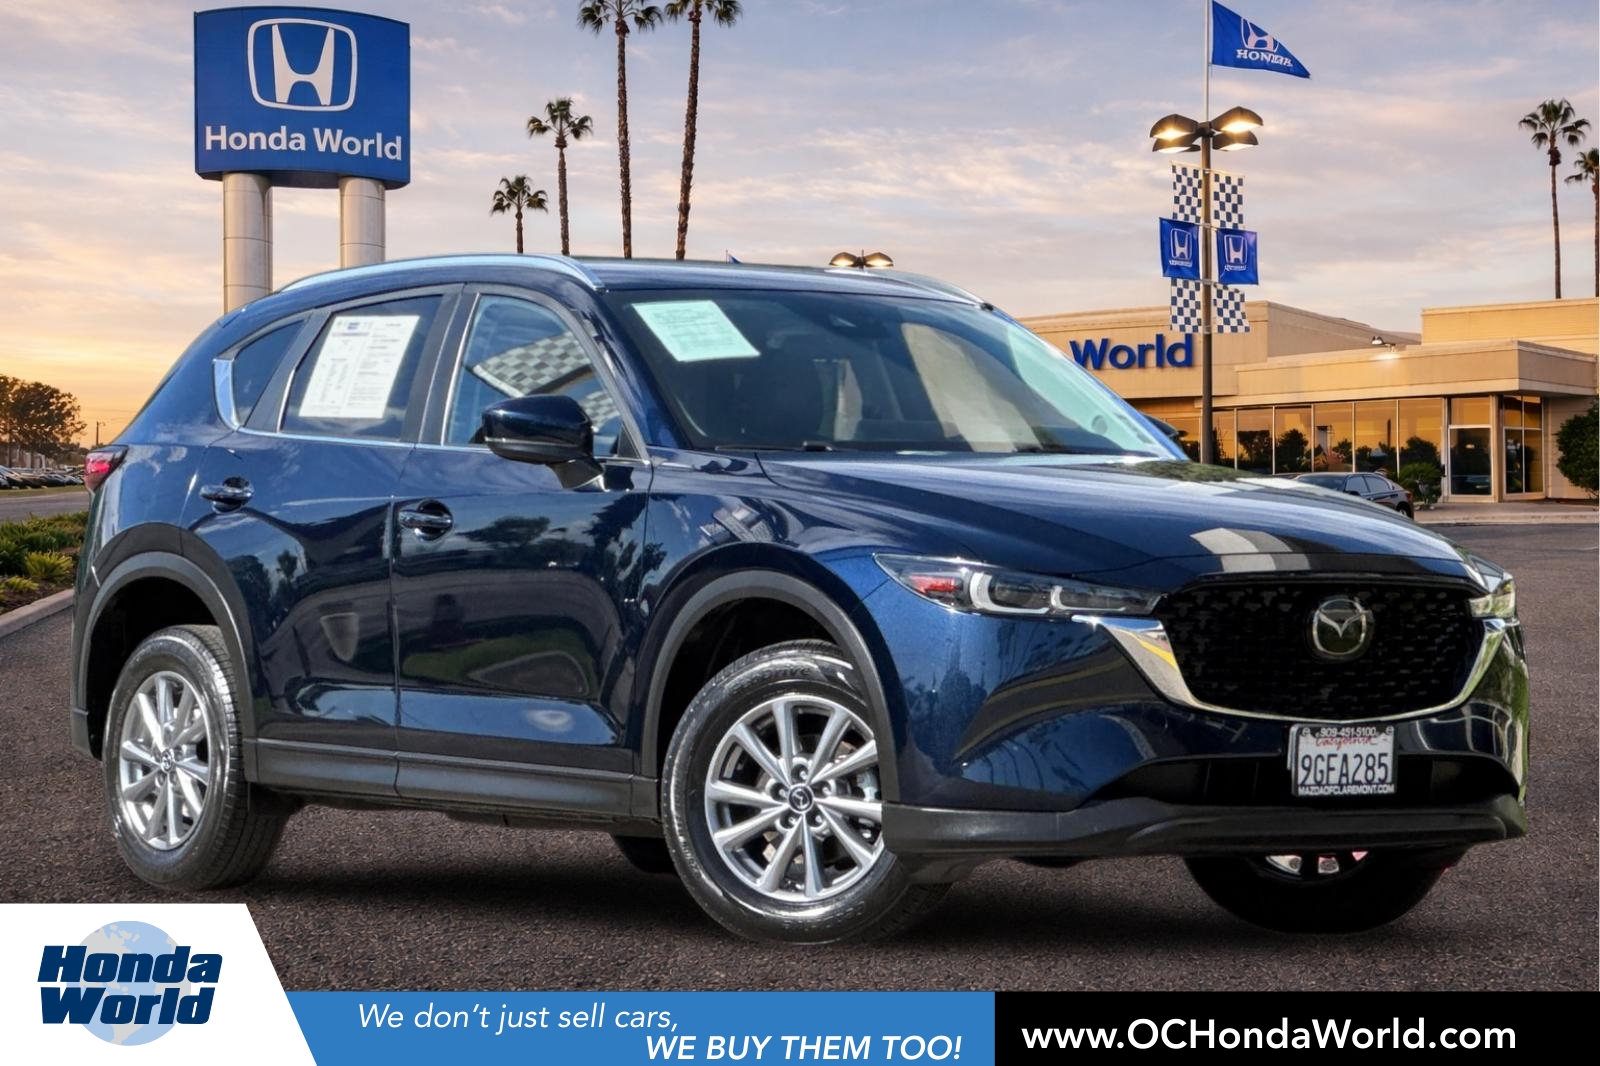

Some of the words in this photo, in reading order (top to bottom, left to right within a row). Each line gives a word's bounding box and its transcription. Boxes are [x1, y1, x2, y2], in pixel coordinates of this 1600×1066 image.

[205, 125, 306, 151] Honda
[313, 127, 402, 161] World
[1069, 333, 1193, 371] World
[1300, 752, 1389, 785] 9GFA285
